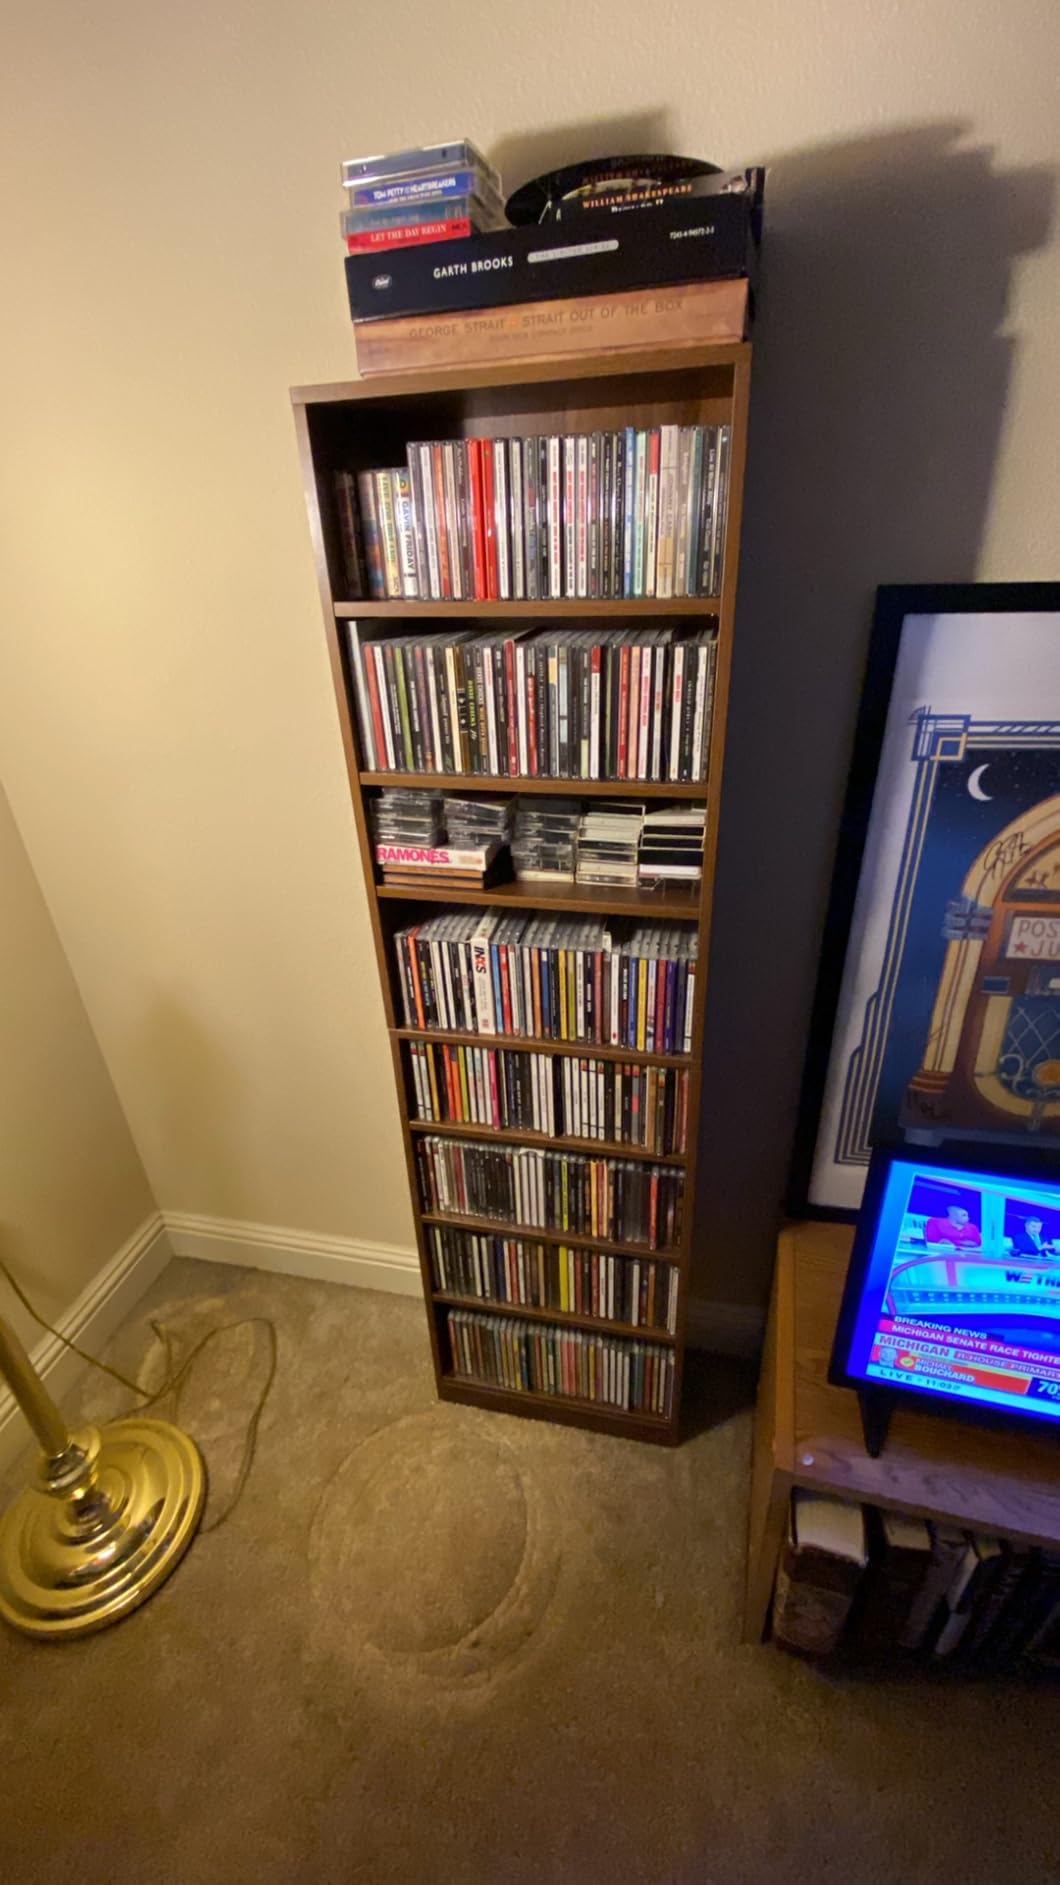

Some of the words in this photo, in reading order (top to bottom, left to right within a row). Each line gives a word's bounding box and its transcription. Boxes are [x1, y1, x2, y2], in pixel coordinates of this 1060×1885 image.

[387, 187, 403, 198] PETTY
[583, 195, 623, 208] WILLIAM
[627, 184, 693, 199] SHAKESPEARE
[370, 231, 384, 242] LET
[388, 228, 402, 240] THE
[405, 226, 419, 238] DAY
[421, 223, 446, 235] BEGIN
[433, 265, 467, 279] GARTH
[471, 256, 514, 273] BROOKS
[409, 324, 457, 341] GEORGE
[464, 319, 504, 334] STRAIT
[522, 313, 563, 327] STRAIT
[569, 310, 594, 321] OUT
[600, 307, 618, 319] OF
[624, 303, 647, 315] THE
[655, 300, 683, 313] BOX
[402, 501, 410, 530] GAVIN
[405, 532, 416, 569] FRIDAY
[376, 847, 450, 864] RAMONES
[1018, 919, 1060, 939] POS
[474, 946, 486, 974] INXS
[894, 1315, 952, 1333] BREAKING
[953, 1327, 987, 1340] NEWS
[879, 1335, 950, 1357] MICHIGAN
[892, 1325, 944, 1341] MICHIGAN
[946, 1335, 987, 1350] SENATE
[989, 1343, 1020, 1357] RACE
[880, 1369, 912, 1380] LIVE
[915, 1364, 974, 1383] BOUCHARD
